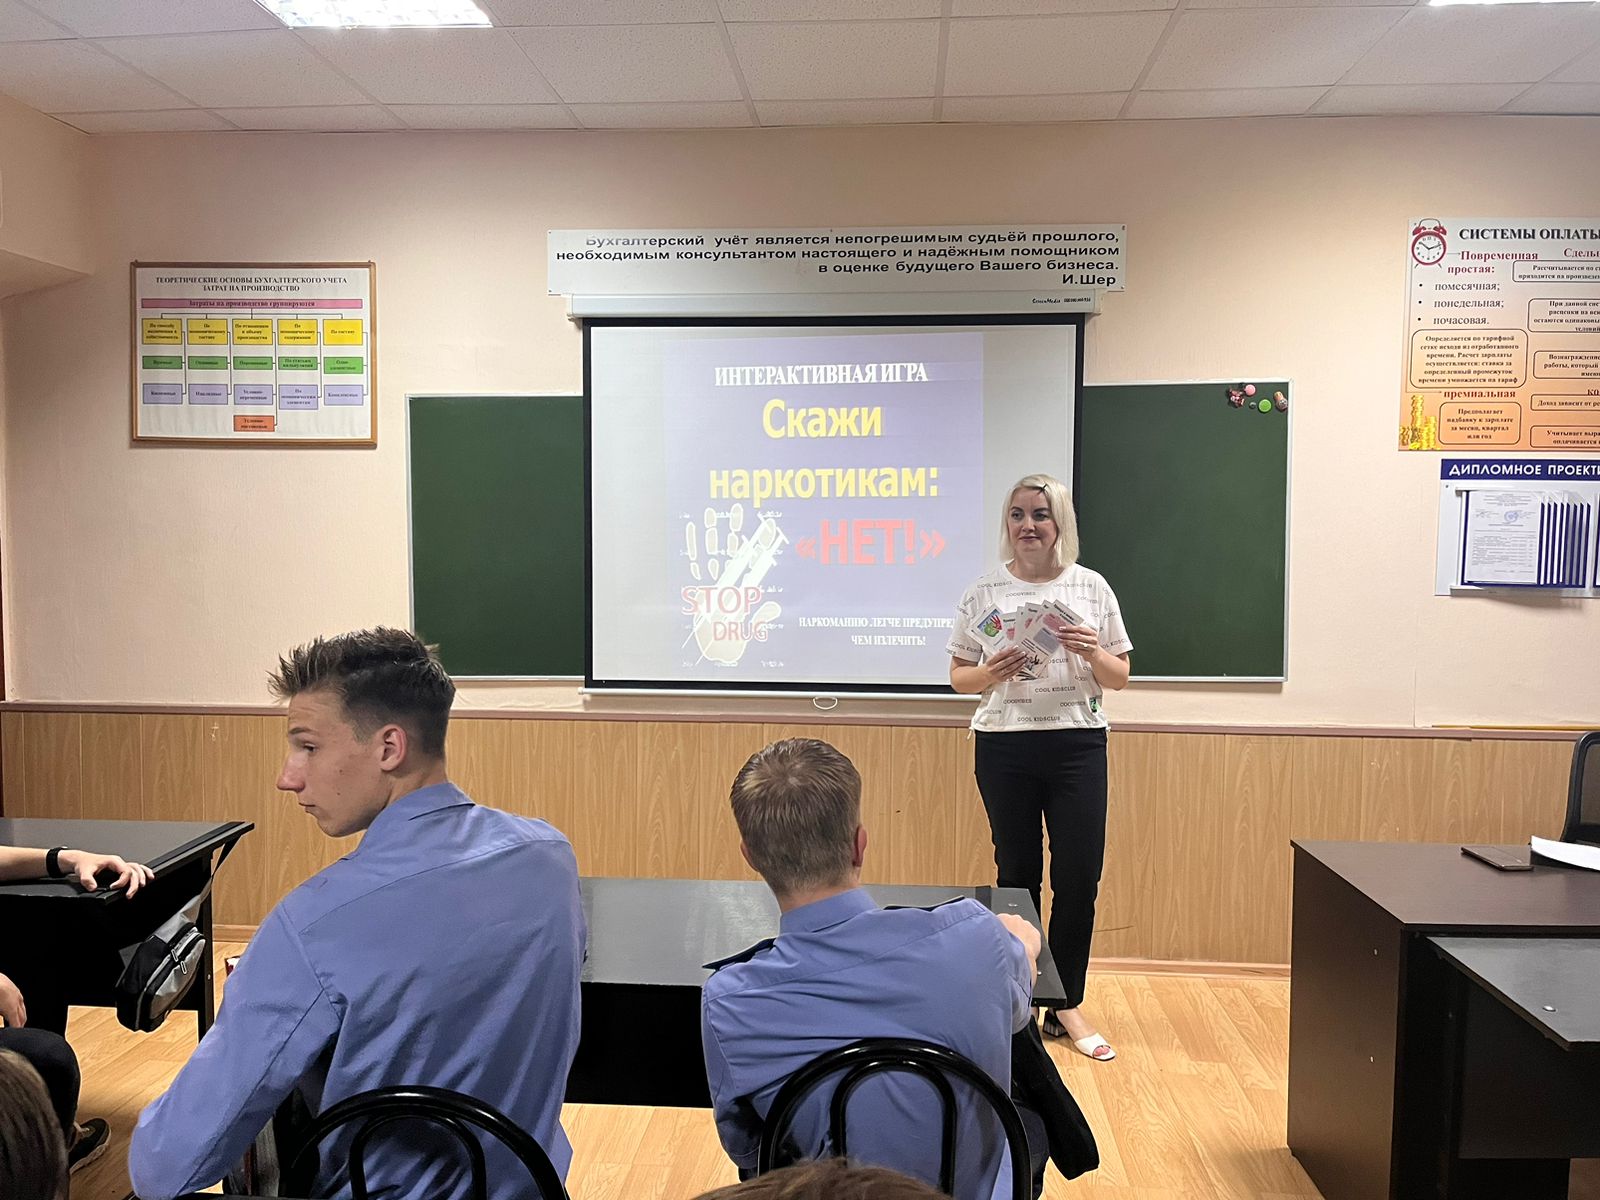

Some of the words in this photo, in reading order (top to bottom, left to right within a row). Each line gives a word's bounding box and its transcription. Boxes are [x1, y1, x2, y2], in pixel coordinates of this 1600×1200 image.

[586, 235, 704, 248] Бухгалтерский
[714, 235, 748, 248] учёт
[755, 236, 830, 246] является
[836, 233, 962, 246] непогрешимым
[968, 231, 1026, 246] судьёй
[1032, 232, 1120, 244] прошлого,
[1458, 228, 1536, 240] СИСТЕМЫ
[556, 250, 670, 262] необходимым
[676, 250, 796, 260] консультантом
[802, 248, 896, 260] настоящего
[918, 246, 1005, 259] надёжным
[1010, 246, 1120, 258] помощником
[1460, 250, 1538, 262] Повременная
[818, 264, 828, 273] в
[834, 262, 889, 274] оценке
[896, 260, 975, 274] будущего
[980, 260, 1042, 271] Вашего
[1046, 258, 1119, 271] бизнеса.
[1448, 266, 1495, 276] простая:
[1062, 274, 1116, 286] И.Шер
[1433, 316, 1490, 325] почасовая.
[714, 364, 878, 386] ИНТЕРАКТИВНАЯ
[880, 362, 928, 383] ИГРА
[1444, 391, 1516, 400] премиальная
[762, 398, 882, 438] Скажи
[1449, 464, 1542, 476] ДИПЛОМНОЕ
[709, 466, 939, 508] наркотикам:
[794, 518, 946, 566] «НЕТ!»
[681, 586, 762, 615] STOP
[799, 616, 868, 628] НАРКОМАНИЮ
[870, 617, 901, 628] ЛЕГЧЕ
[713, 621, 768, 641] DRUG
[852, 635, 872, 645] ЧЕМ
[874, 635, 926, 646] ИЗЛЕЧИТЬ!
